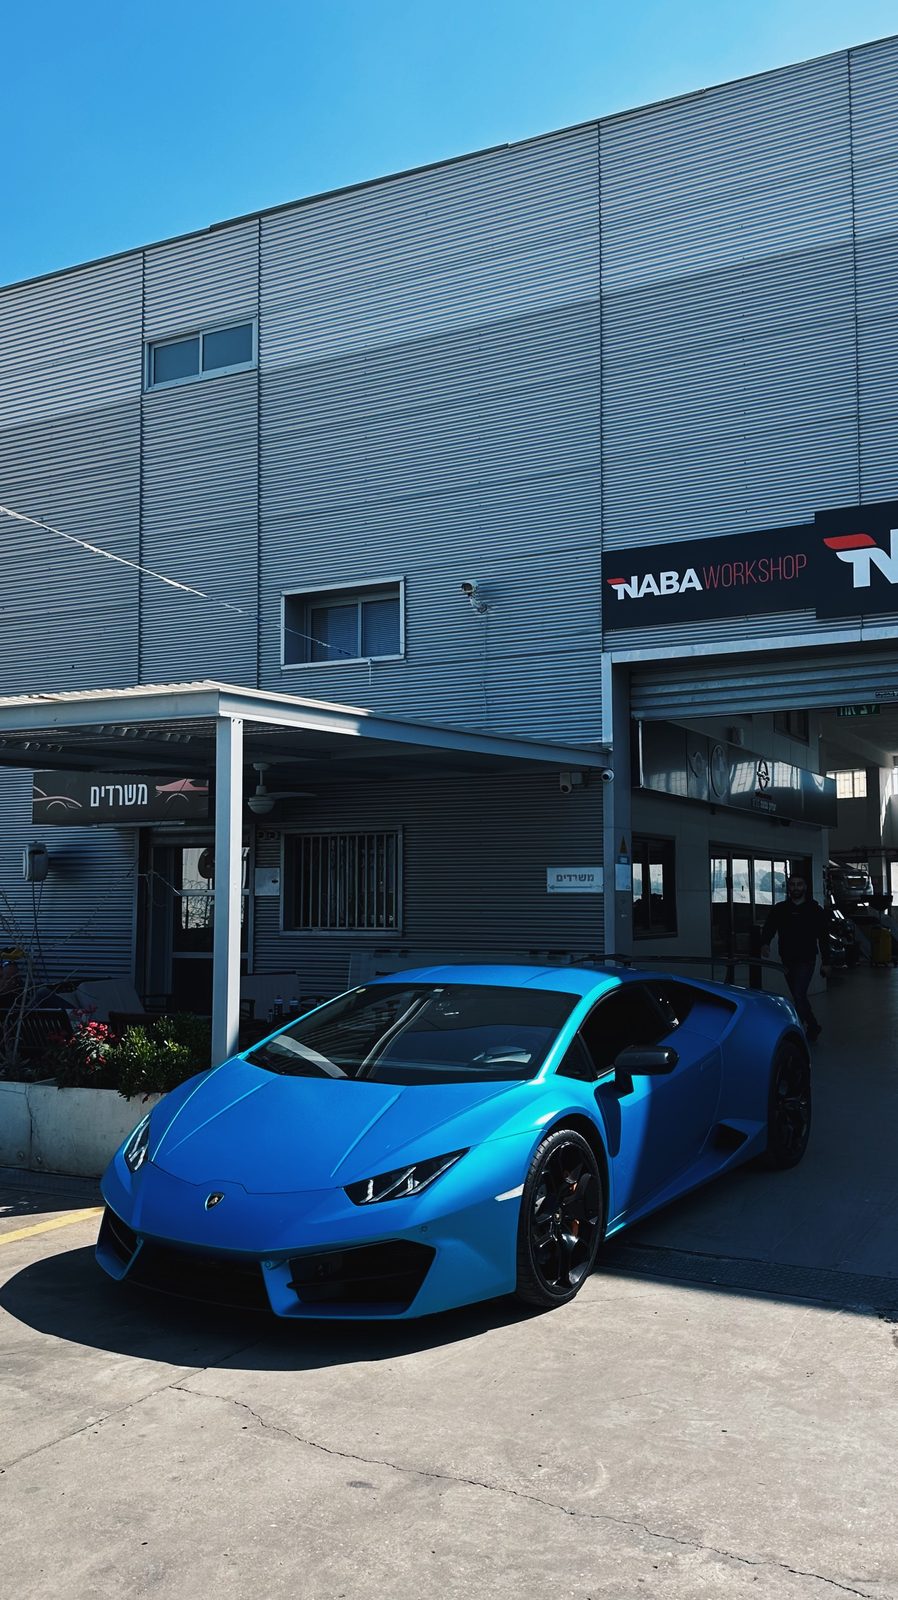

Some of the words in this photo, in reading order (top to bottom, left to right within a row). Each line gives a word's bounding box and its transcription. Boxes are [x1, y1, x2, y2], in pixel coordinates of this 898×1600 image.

[607, 567, 703, 600] NABA
[703, 554, 807, 589] WORKSHOP
[90, 784, 148, 807] משרדים
[556, 873, 595, 883] משרדים
